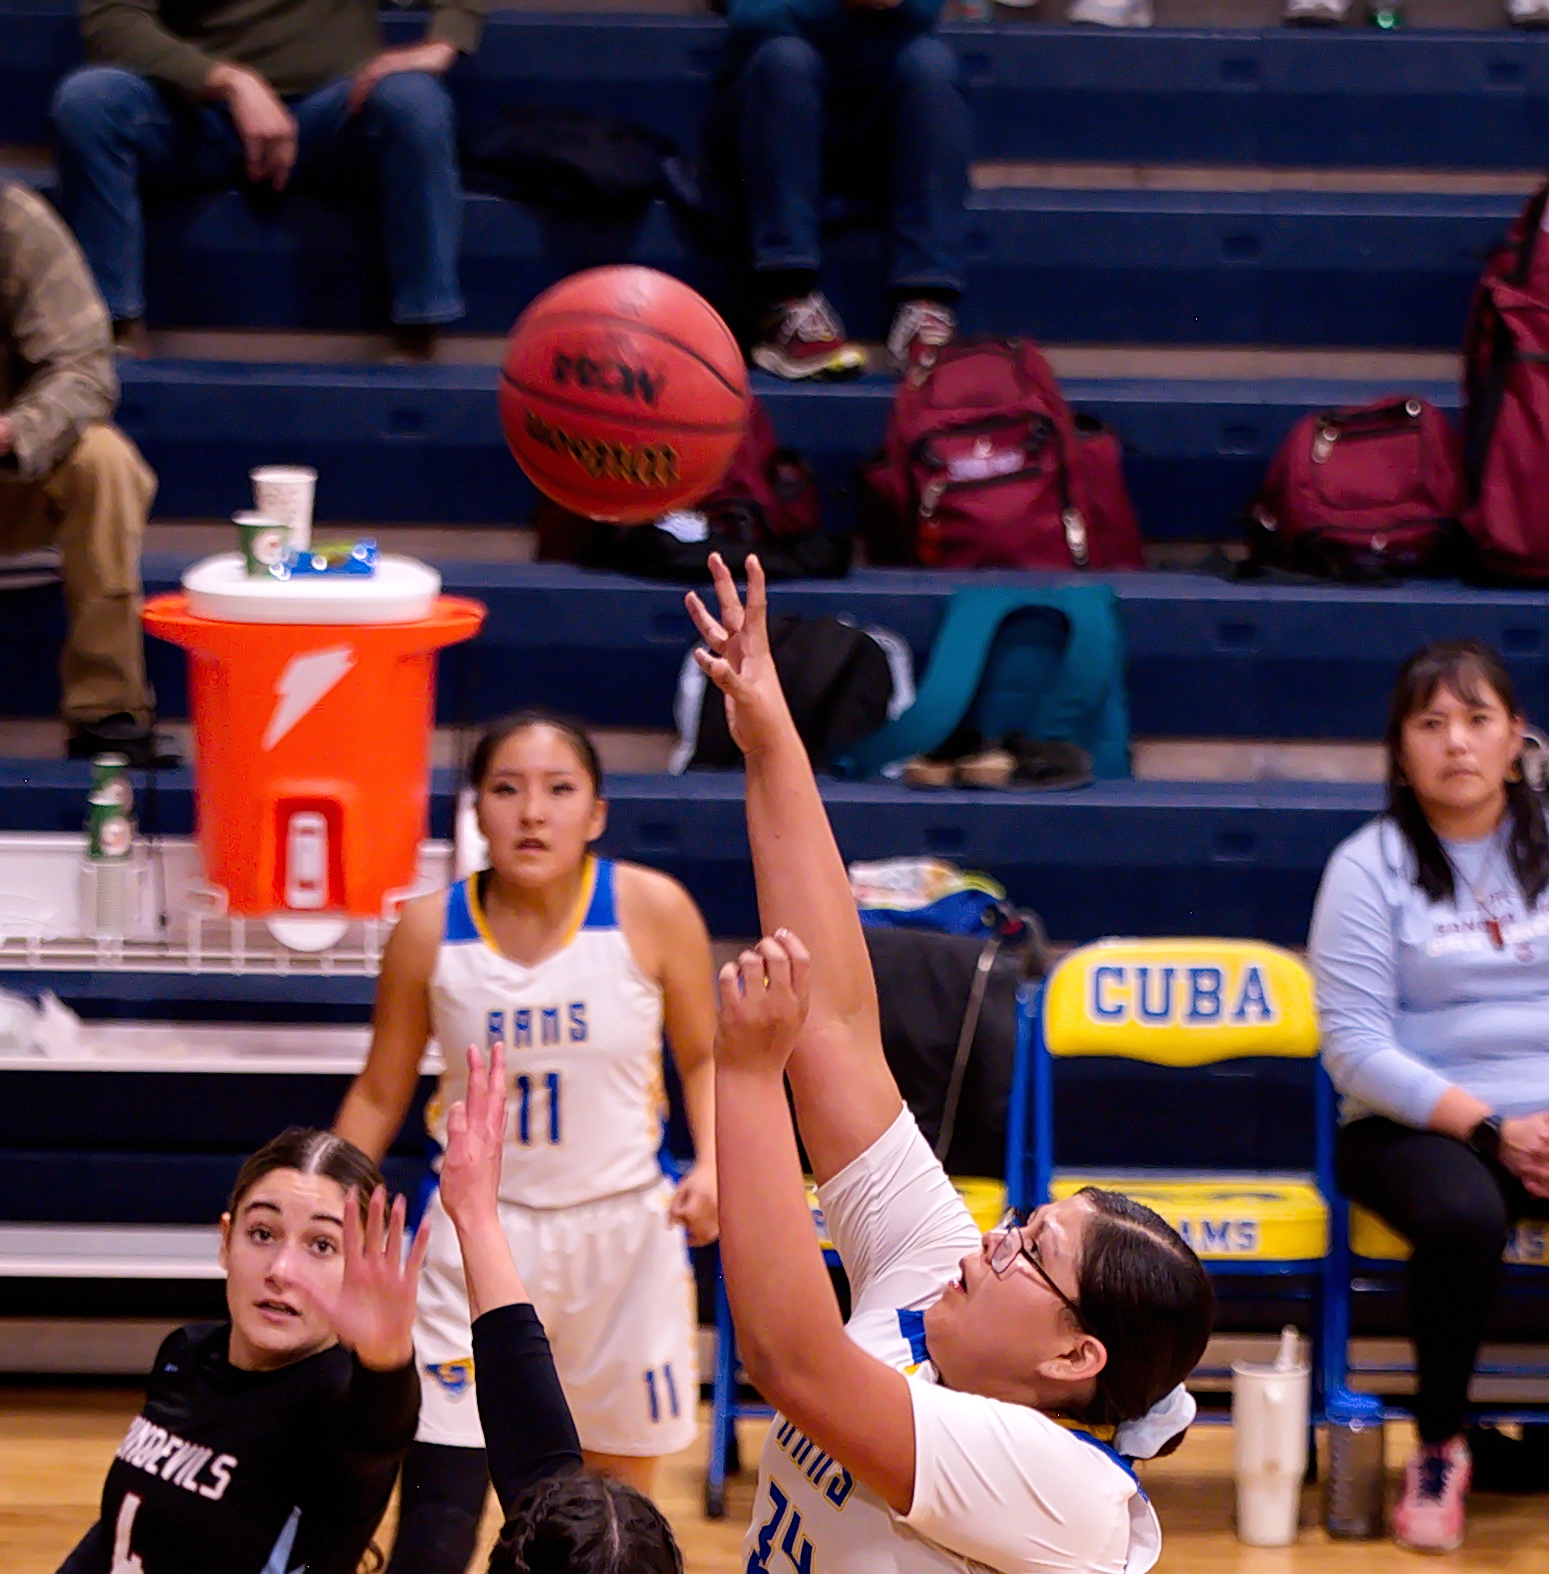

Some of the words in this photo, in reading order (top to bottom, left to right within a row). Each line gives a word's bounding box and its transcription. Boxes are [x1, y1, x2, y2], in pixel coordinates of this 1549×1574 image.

[1091, 963, 1275, 1023] CUBA
[487, 1001, 588, 1048] RAMS
[515, 1072, 561, 1146] 11
[1179, 1220, 1257, 1250] AMS
[644, 1363, 680, 1423] 11
